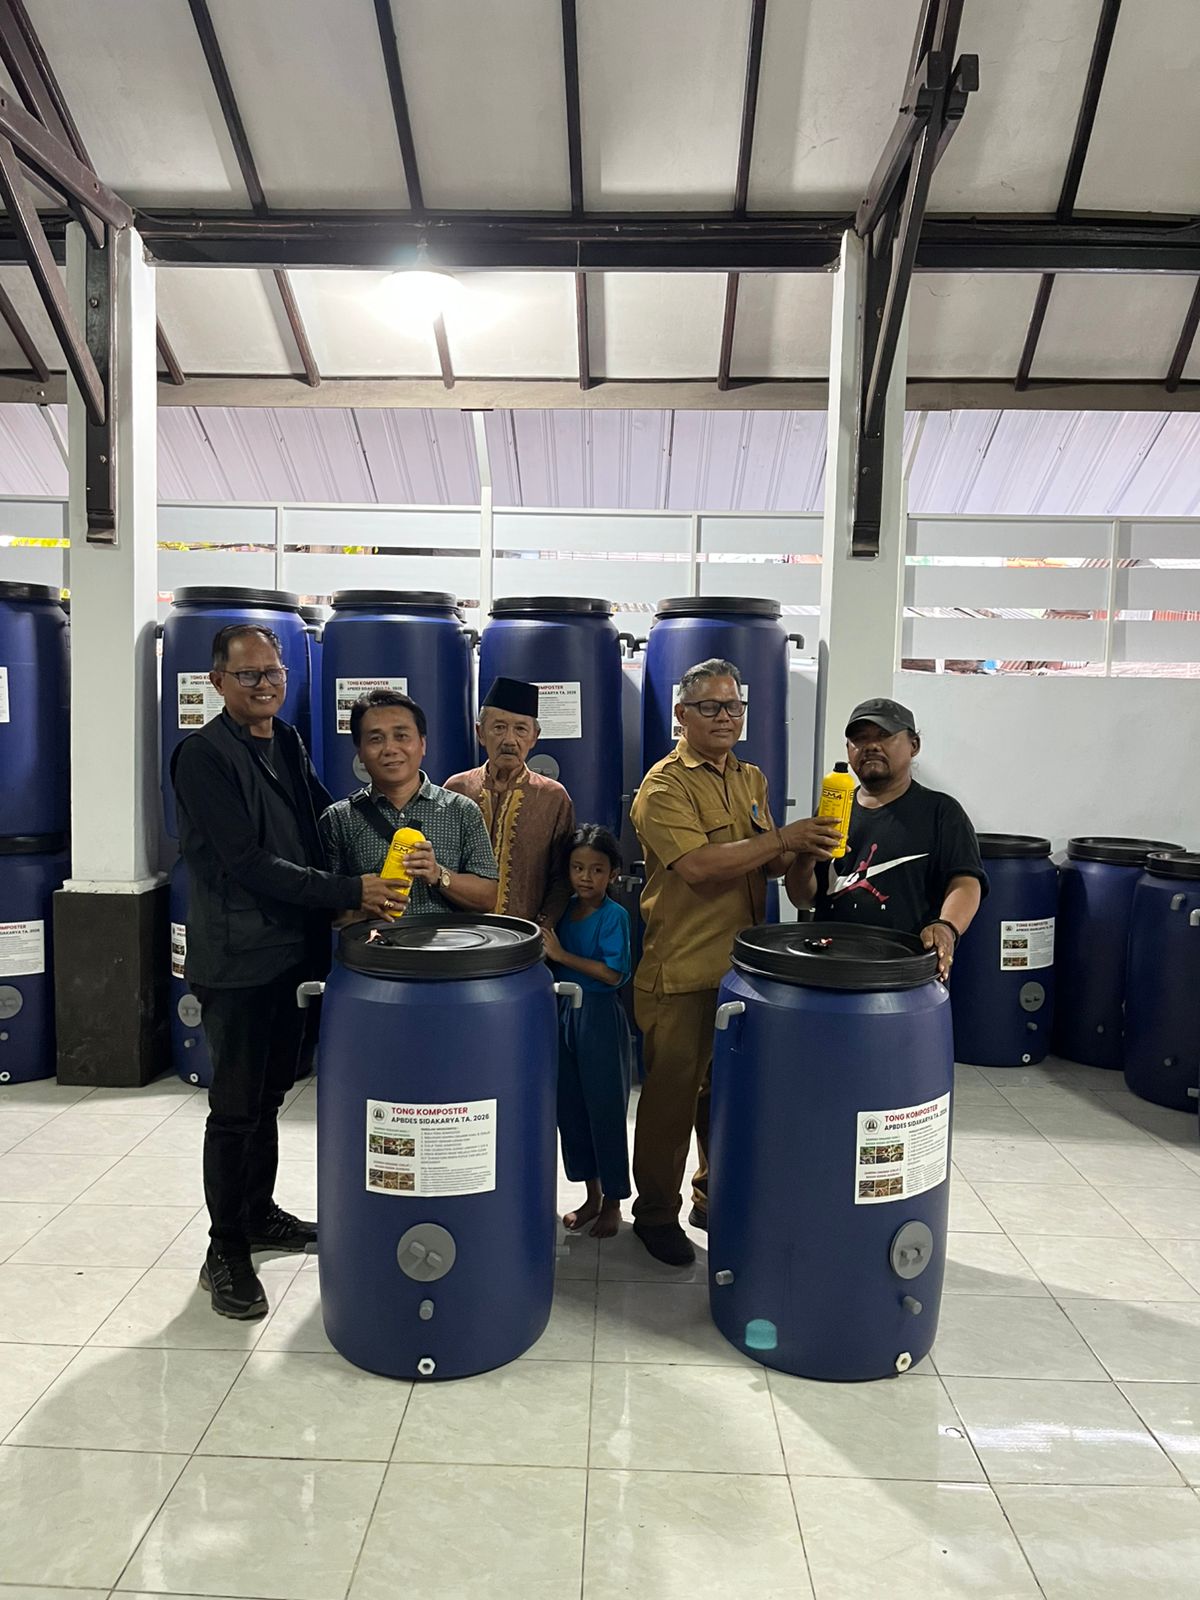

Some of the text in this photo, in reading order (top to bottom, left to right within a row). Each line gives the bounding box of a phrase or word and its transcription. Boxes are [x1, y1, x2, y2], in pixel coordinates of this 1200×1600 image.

[391, 1107, 468, 1116] TONG KOMPOSTER
[885, 1104, 938, 1122] TONG KOMPOSTER
[419, 1117, 460, 1125] SIDAKARYA
[473, 1113, 490, 1121] 2026
[884, 1122, 907, 1130] APBDES
